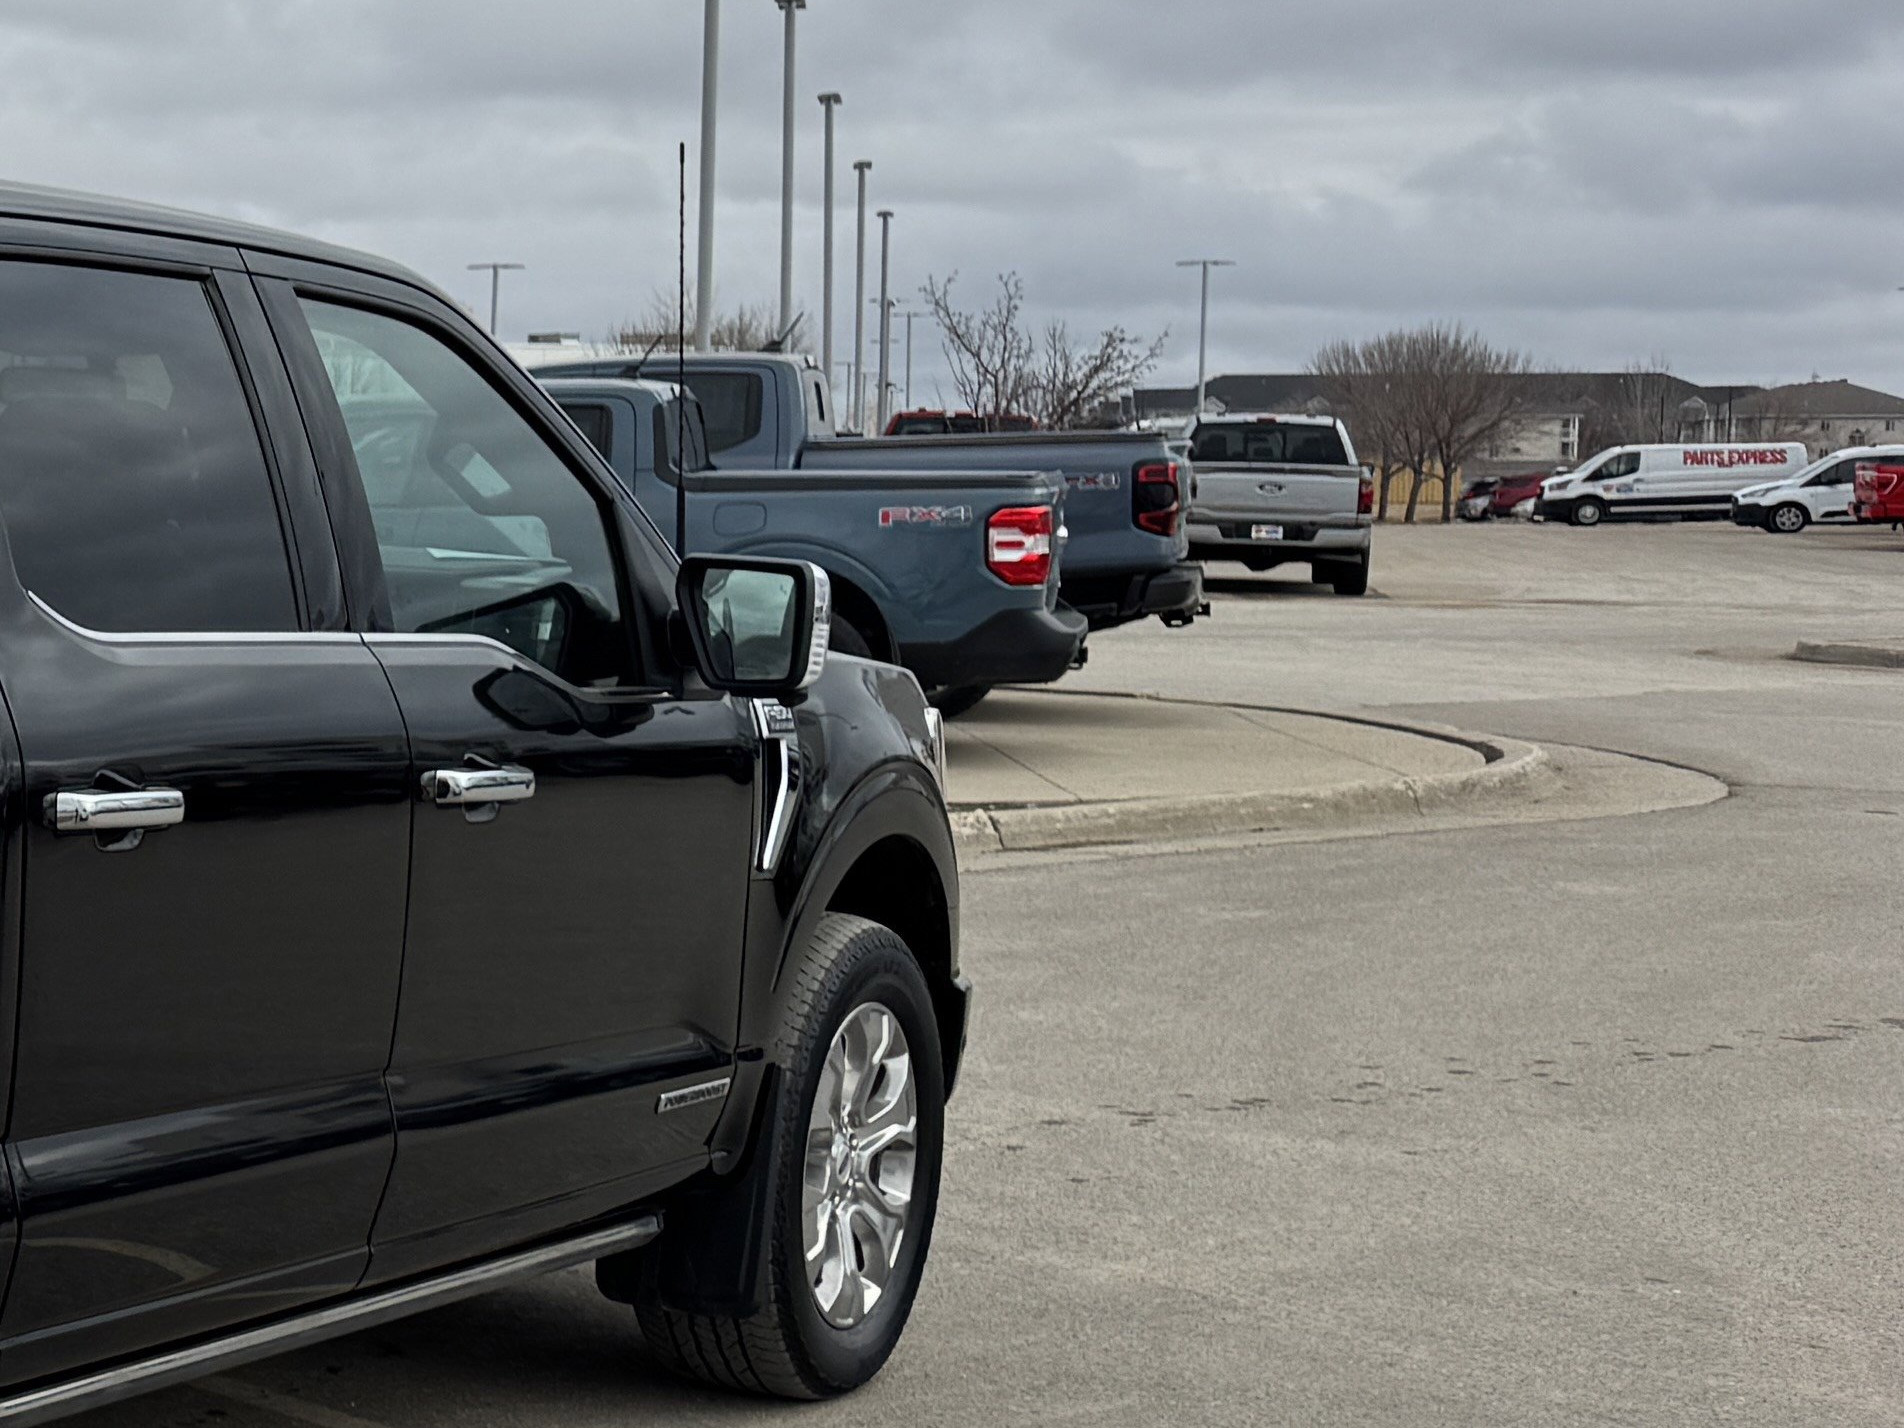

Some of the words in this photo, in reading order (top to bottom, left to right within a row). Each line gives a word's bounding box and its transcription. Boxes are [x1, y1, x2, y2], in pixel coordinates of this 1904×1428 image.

[1683, 449, 1725, 467] PARTS
[1727, 448, 1788, 466] EXPRESS
[878, 504, 973, 527] FX4
